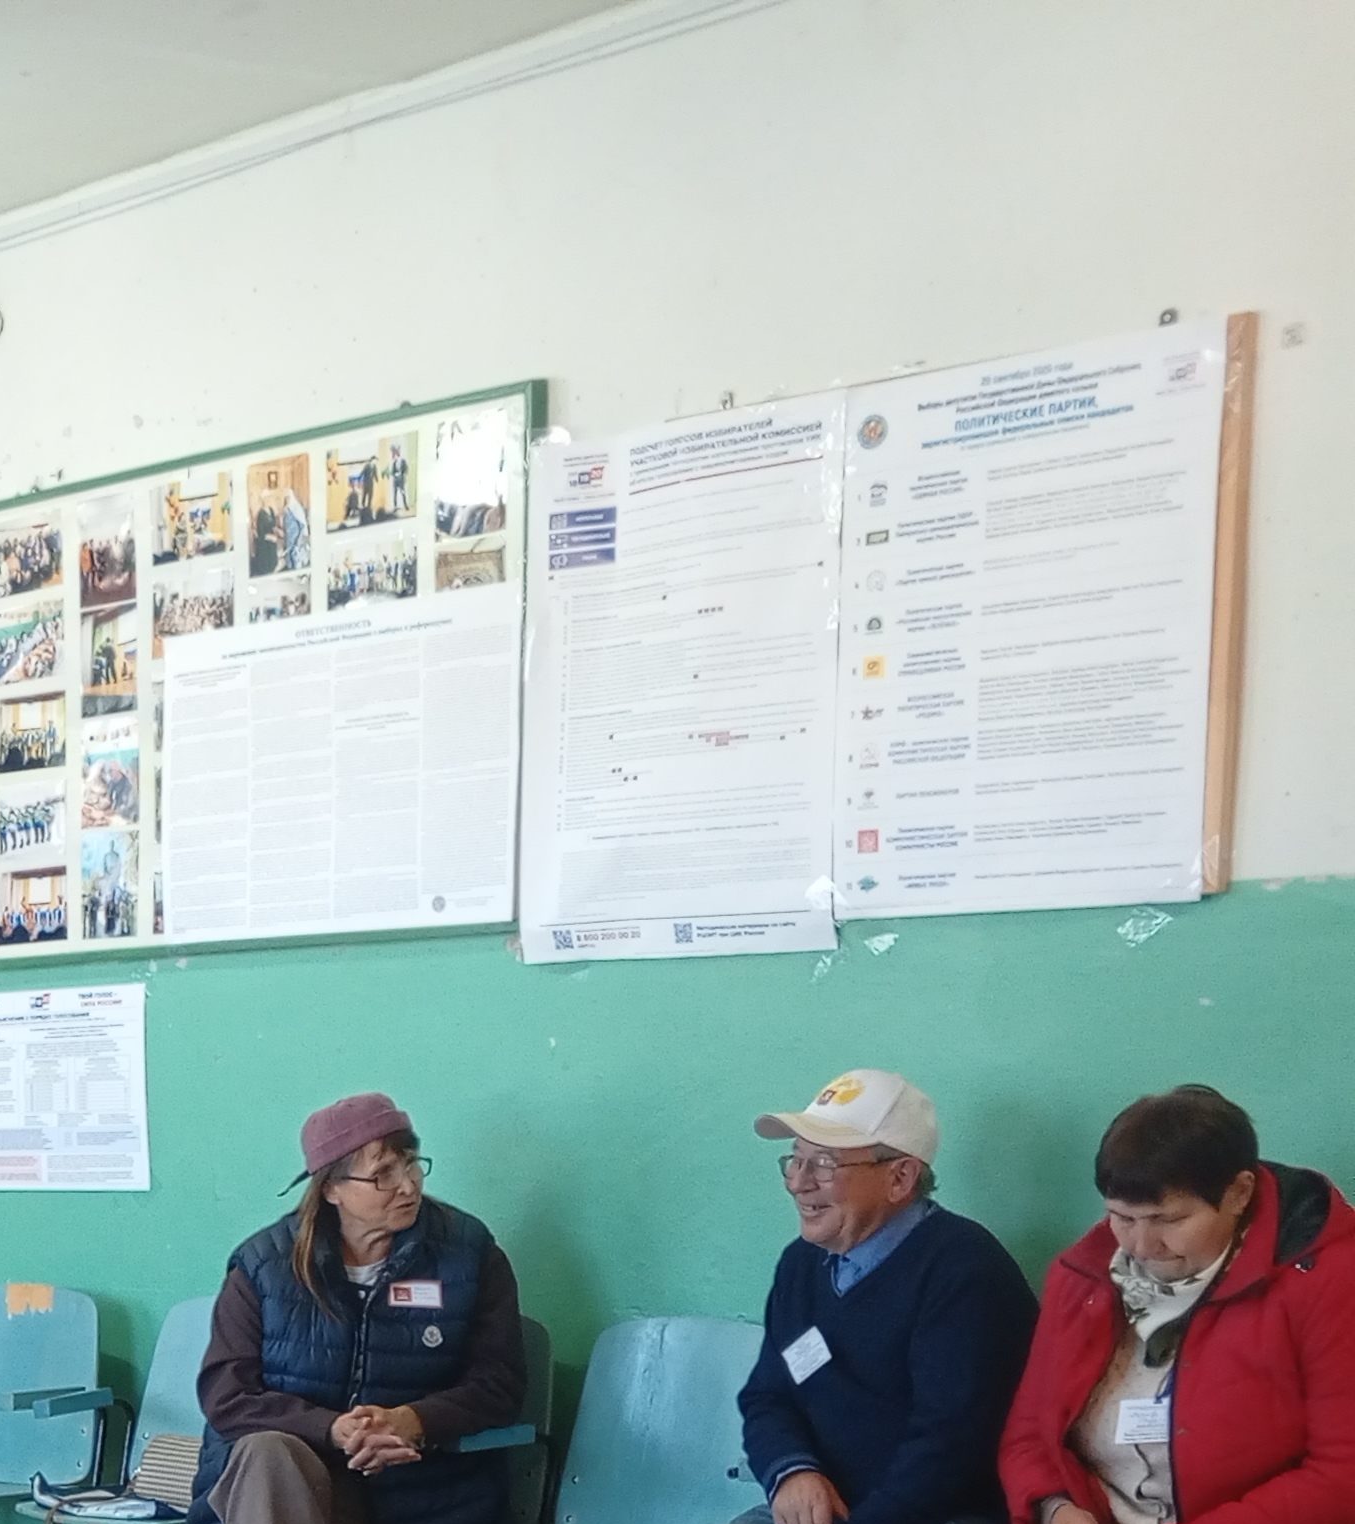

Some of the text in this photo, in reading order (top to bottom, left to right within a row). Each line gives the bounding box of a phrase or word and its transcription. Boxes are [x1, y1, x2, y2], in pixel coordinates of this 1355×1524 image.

[955, 396, 1098, 431] ПОЛИТИЧЕСКИЕ ПАРТИИ,
[705, 417, 773, 438] ИЗБИРАТЕЛЕЙ
[630, 448, 678, 466] УЧАСТКОВОЙ
[679, 433, 759, 455] ИЗБИРАТЕЛЬНОЙ
[761, 421, 822, 441] КОМИССИЕЙ
[295, 619, 372, 639] ОТВЕТСТВЕННОСТЬ
[583, 933, 599, 941] 800
[601, 932, 616, 940] 200
[618, 931, 629, 939] 00
[631, 931, 641, 939] 20
